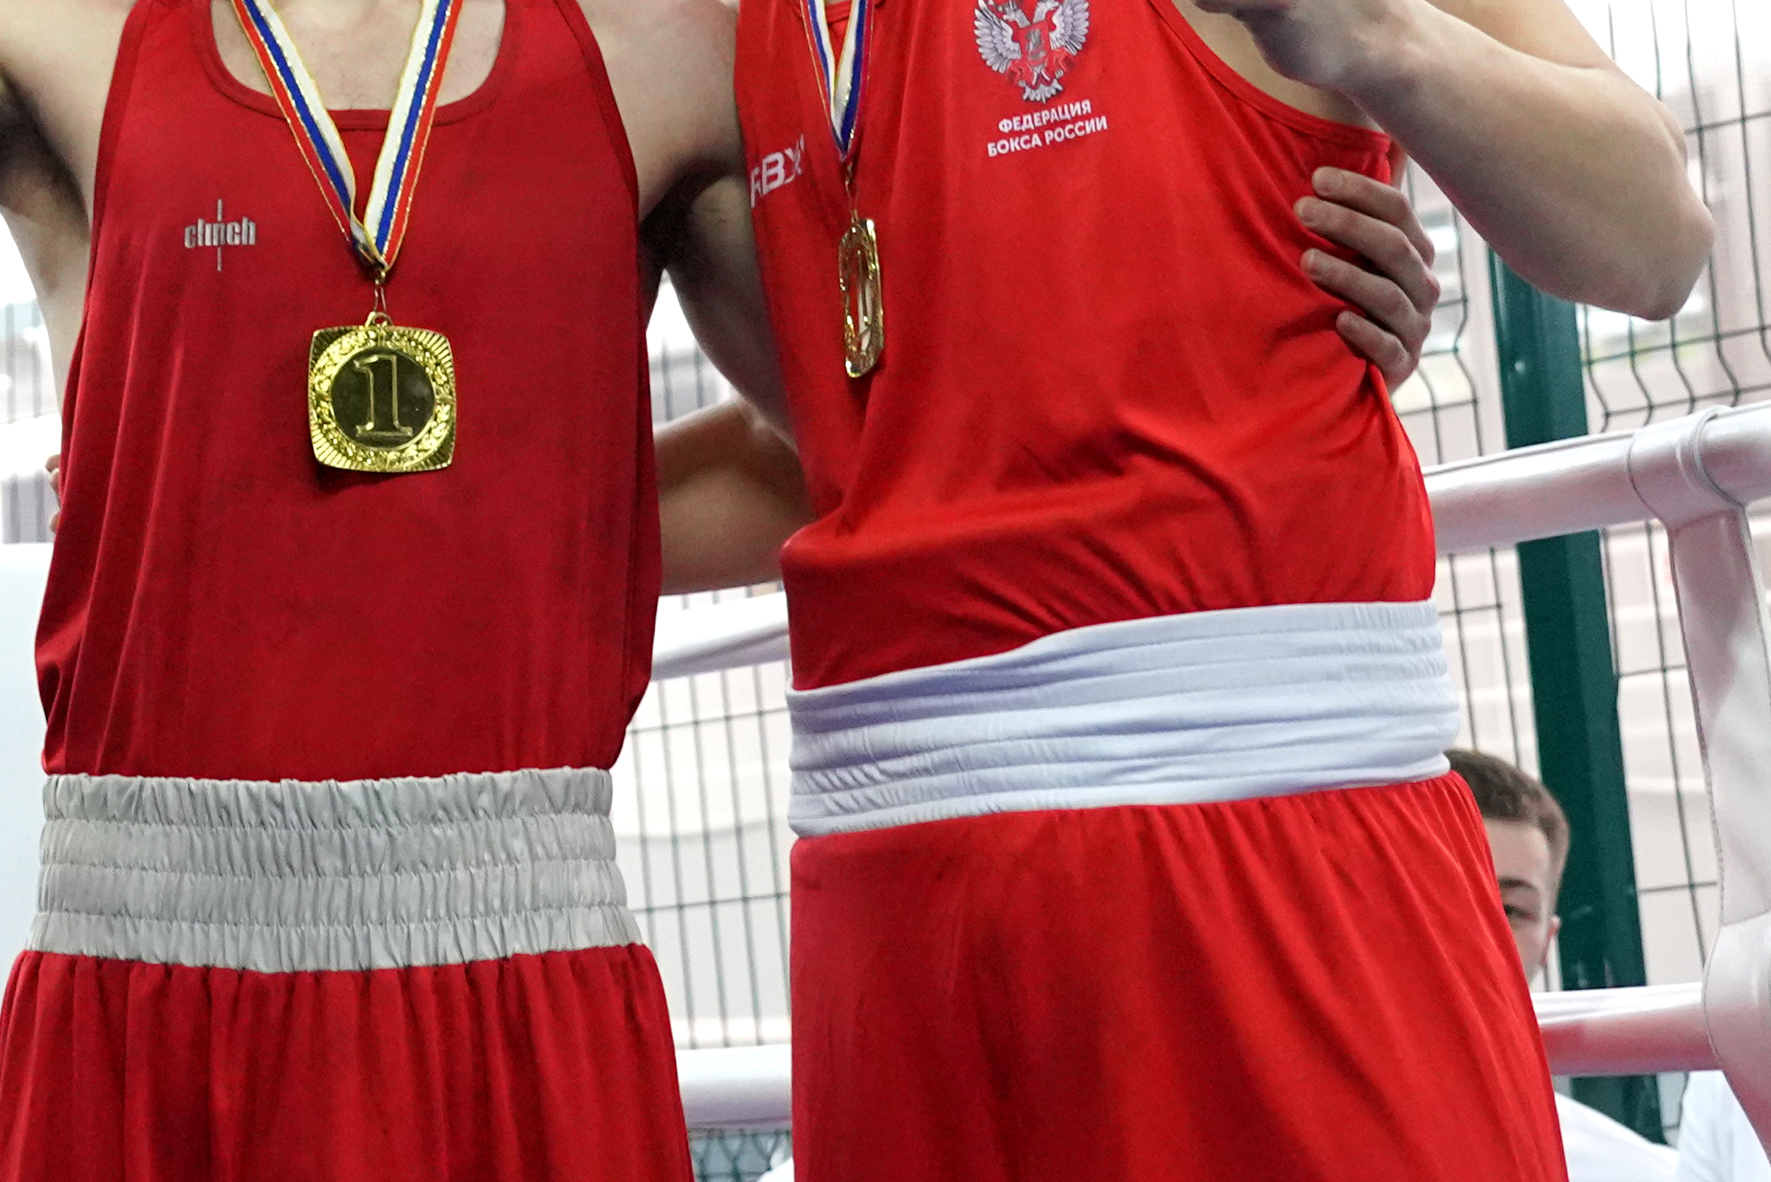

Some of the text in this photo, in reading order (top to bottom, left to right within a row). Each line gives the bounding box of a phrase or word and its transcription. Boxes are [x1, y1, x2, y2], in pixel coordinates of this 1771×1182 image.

[998, 99, 1092, 134] ФЕДЕРАЦИЯ
[987, 115, 1108, 158] БОКСА РОССИИ
[184, 215, 257, 249] clinch
[353, 353, 414, 438] 1
